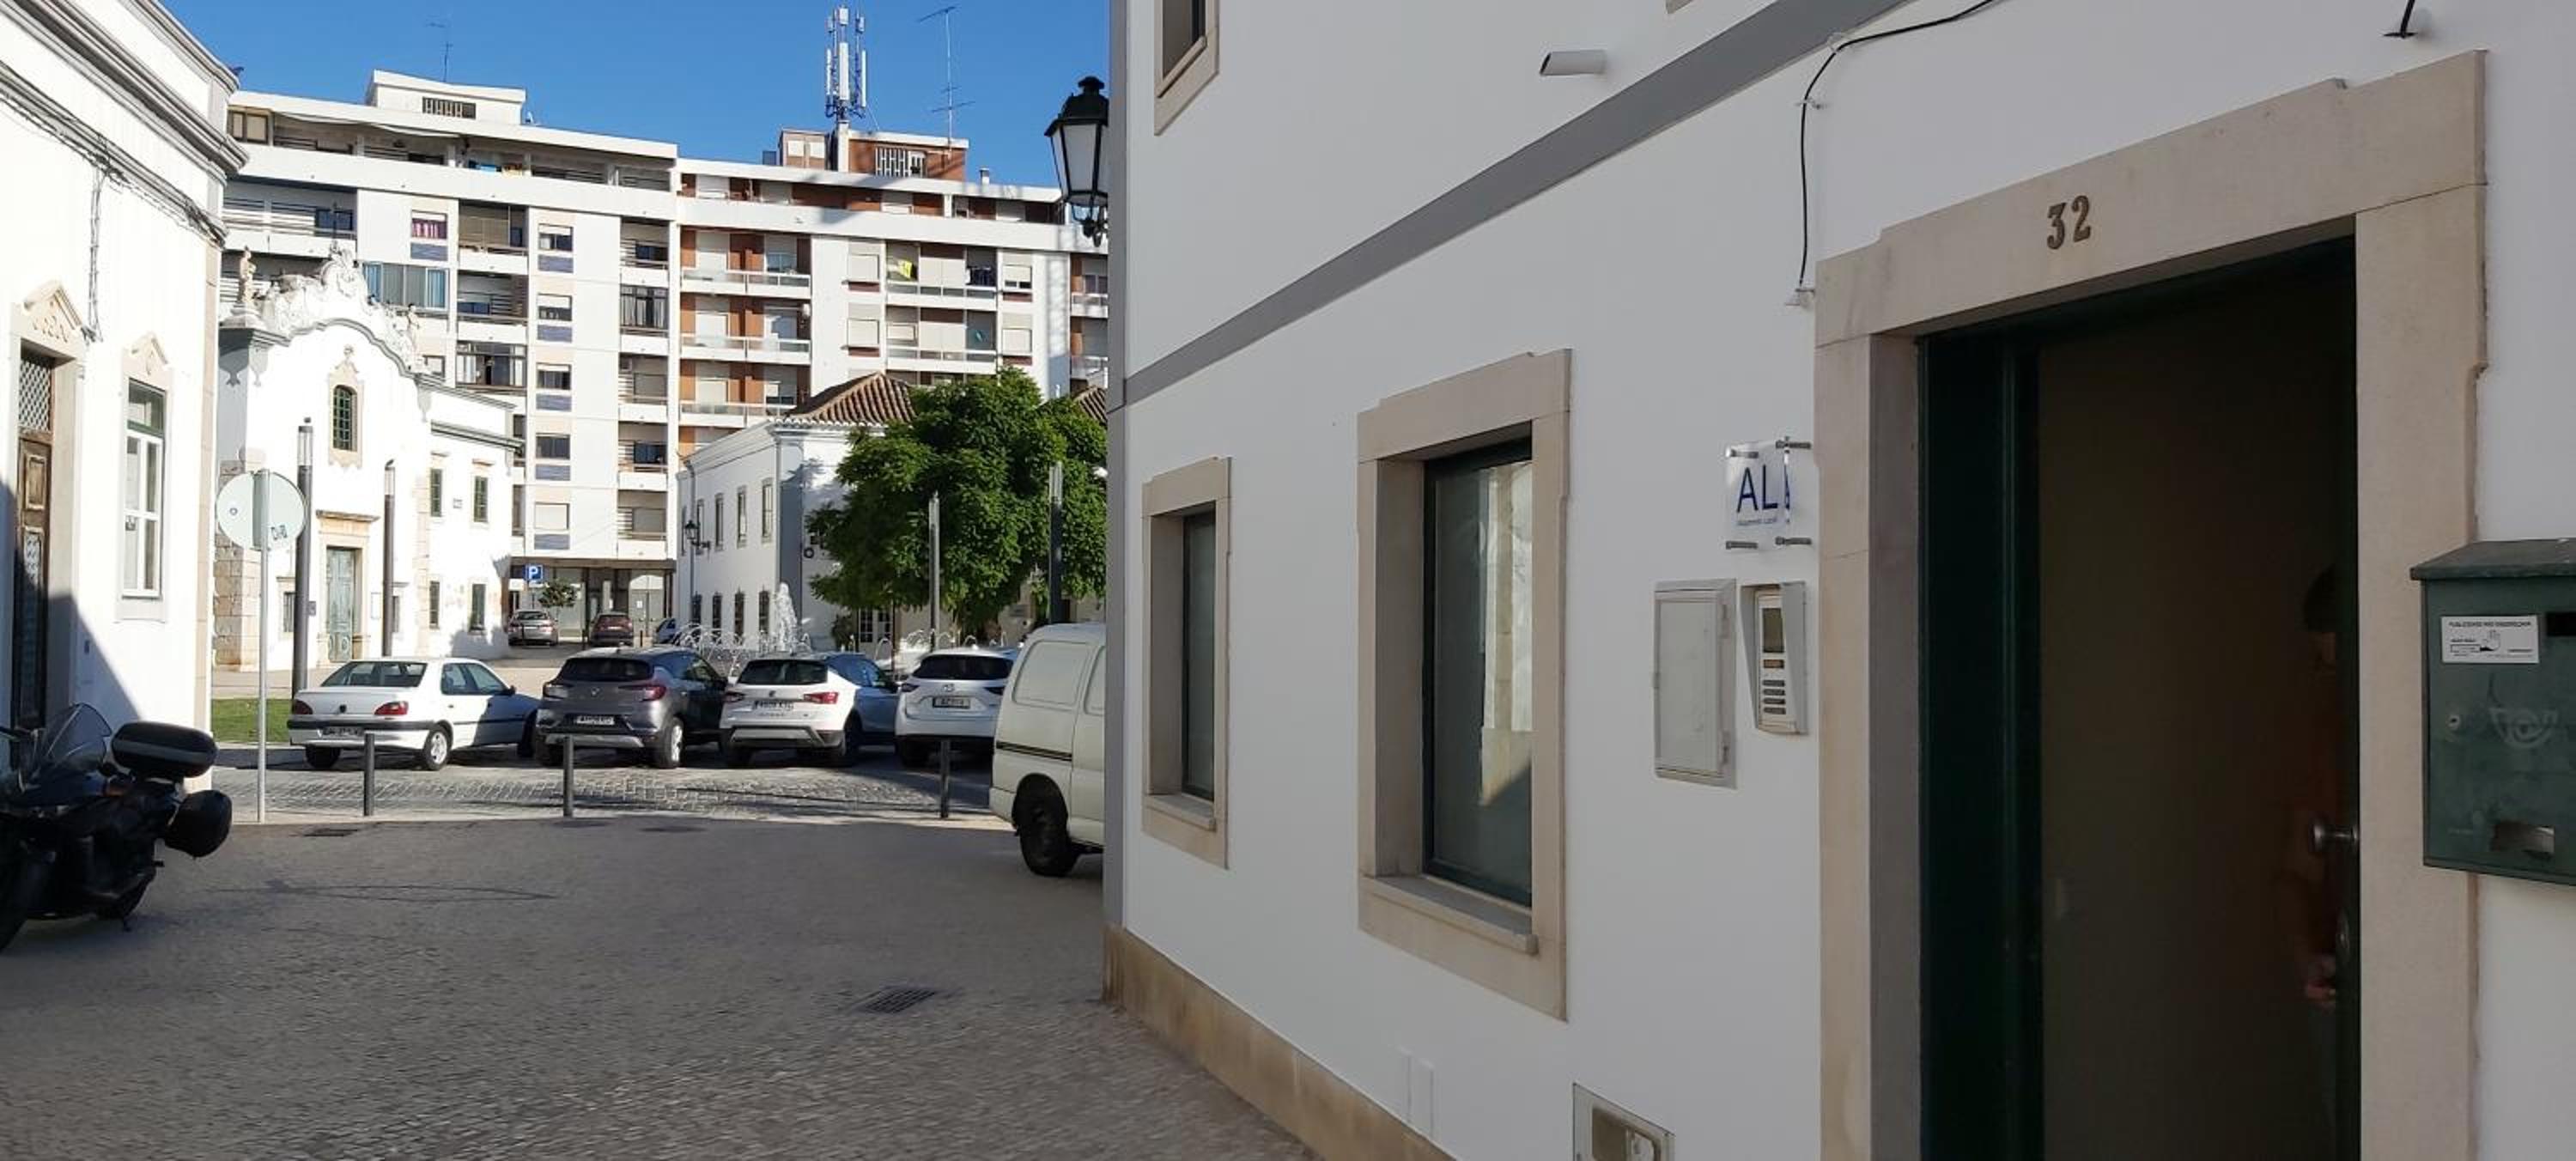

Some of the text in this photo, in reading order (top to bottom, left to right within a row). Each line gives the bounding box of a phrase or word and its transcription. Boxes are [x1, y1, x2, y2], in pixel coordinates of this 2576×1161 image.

[2047, 195, 2092, 250] 32
[1736, 465, 1778, 513] AL
[528, 566, 538, 580] P
